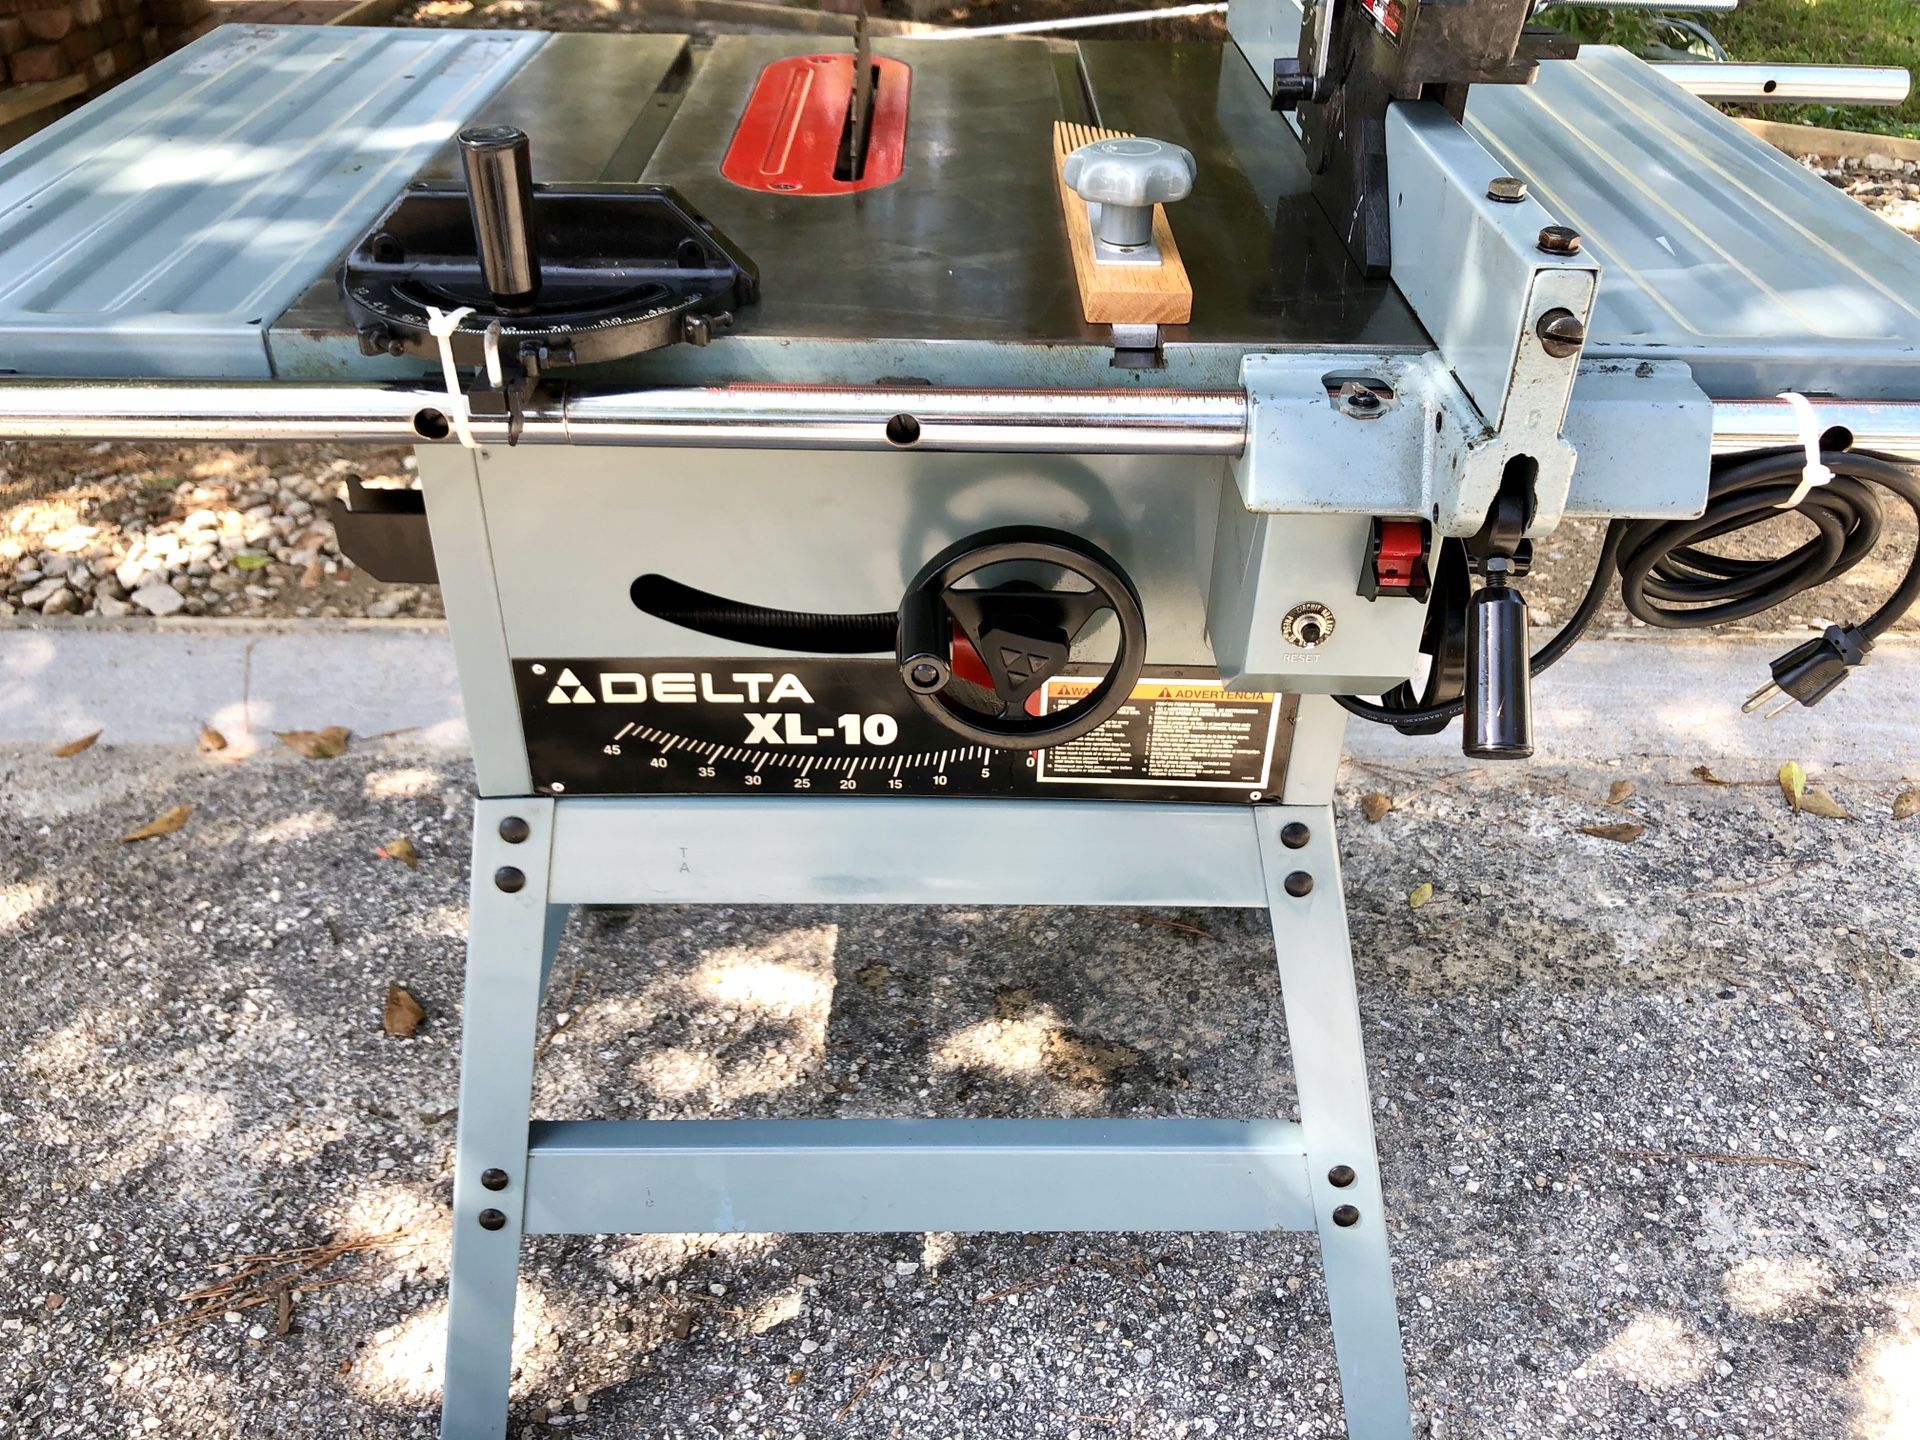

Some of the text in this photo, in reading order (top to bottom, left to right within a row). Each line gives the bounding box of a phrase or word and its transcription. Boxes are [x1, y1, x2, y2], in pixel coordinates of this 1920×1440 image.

[1283, 653, 1321, 663] RESET
[600, 673, 815, 704] DELTA
[1175, 689, 1265, 701] ADVERTENCIA
[744, 713, 899, 746] XL-10
[603, 744, 1036, 790] 45 40 35 30 25 20 15 10 5 0
